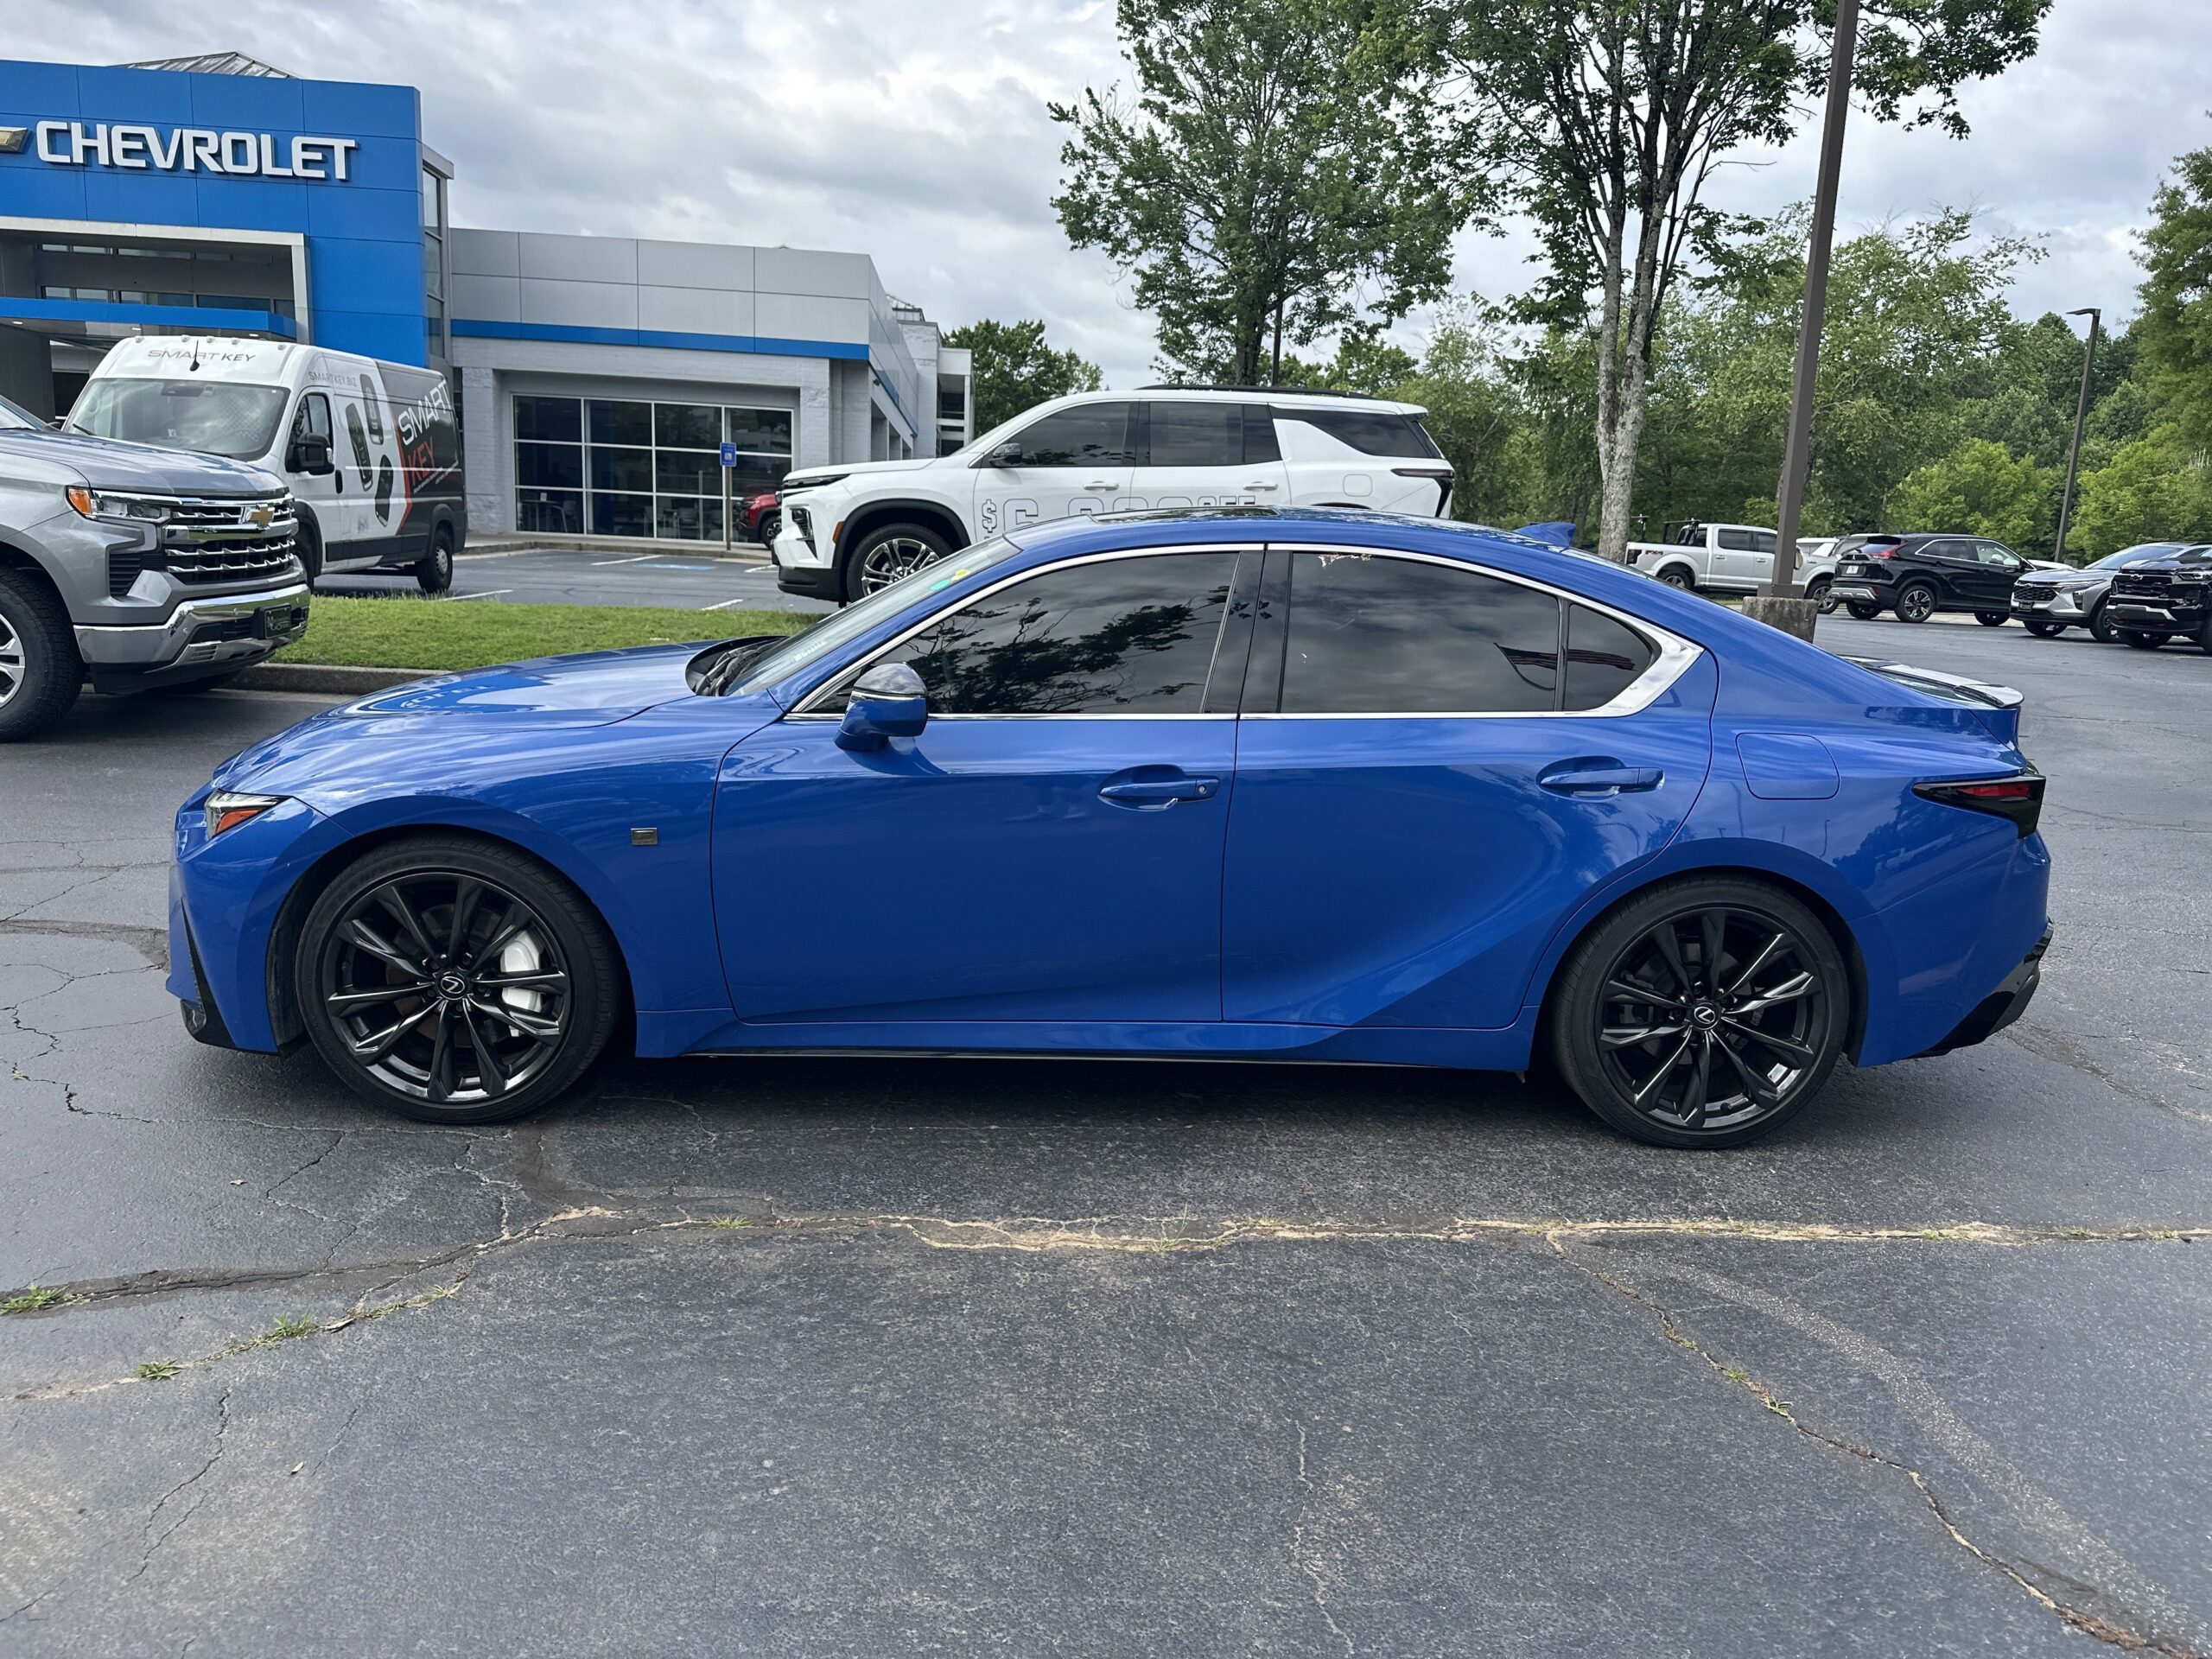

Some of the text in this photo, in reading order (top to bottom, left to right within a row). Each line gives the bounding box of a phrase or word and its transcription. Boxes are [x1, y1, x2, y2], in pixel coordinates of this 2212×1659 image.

[36, 120, 356, 180] CHEVROLET
[148, 349, 257, 362] SMART KEY
[397, 379, 452, 446] SMART
[408, 435, 435, 486] KEY
